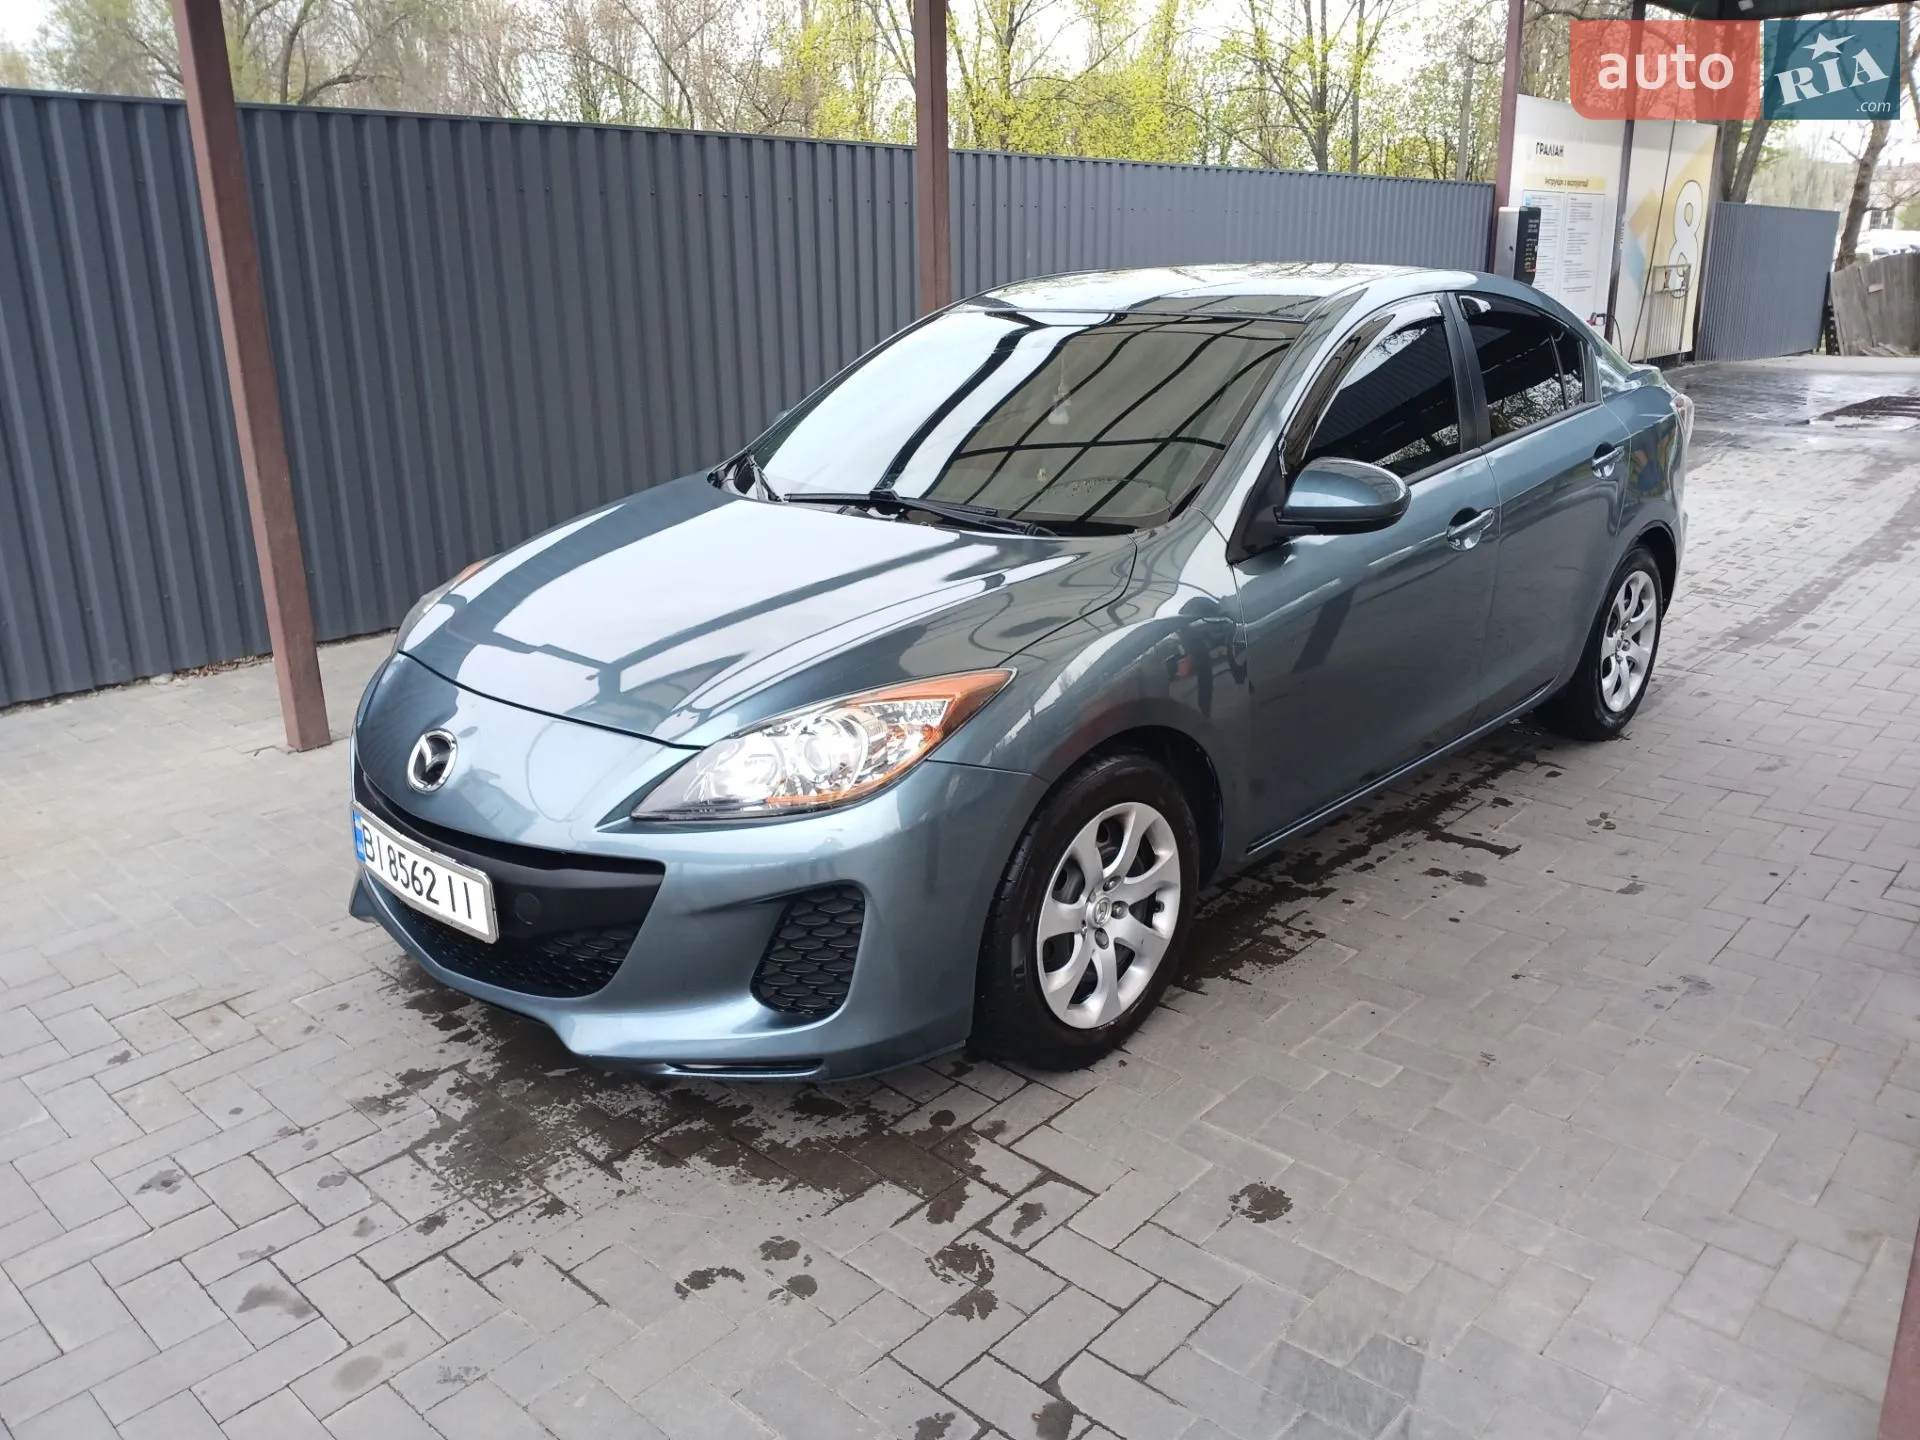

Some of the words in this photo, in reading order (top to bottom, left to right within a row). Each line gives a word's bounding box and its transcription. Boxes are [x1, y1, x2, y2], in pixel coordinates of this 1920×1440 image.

[1668, 180, 1703, 298] 8
[362, 824, 384, 871] BI
[387, 845, 440, 905] 8562
